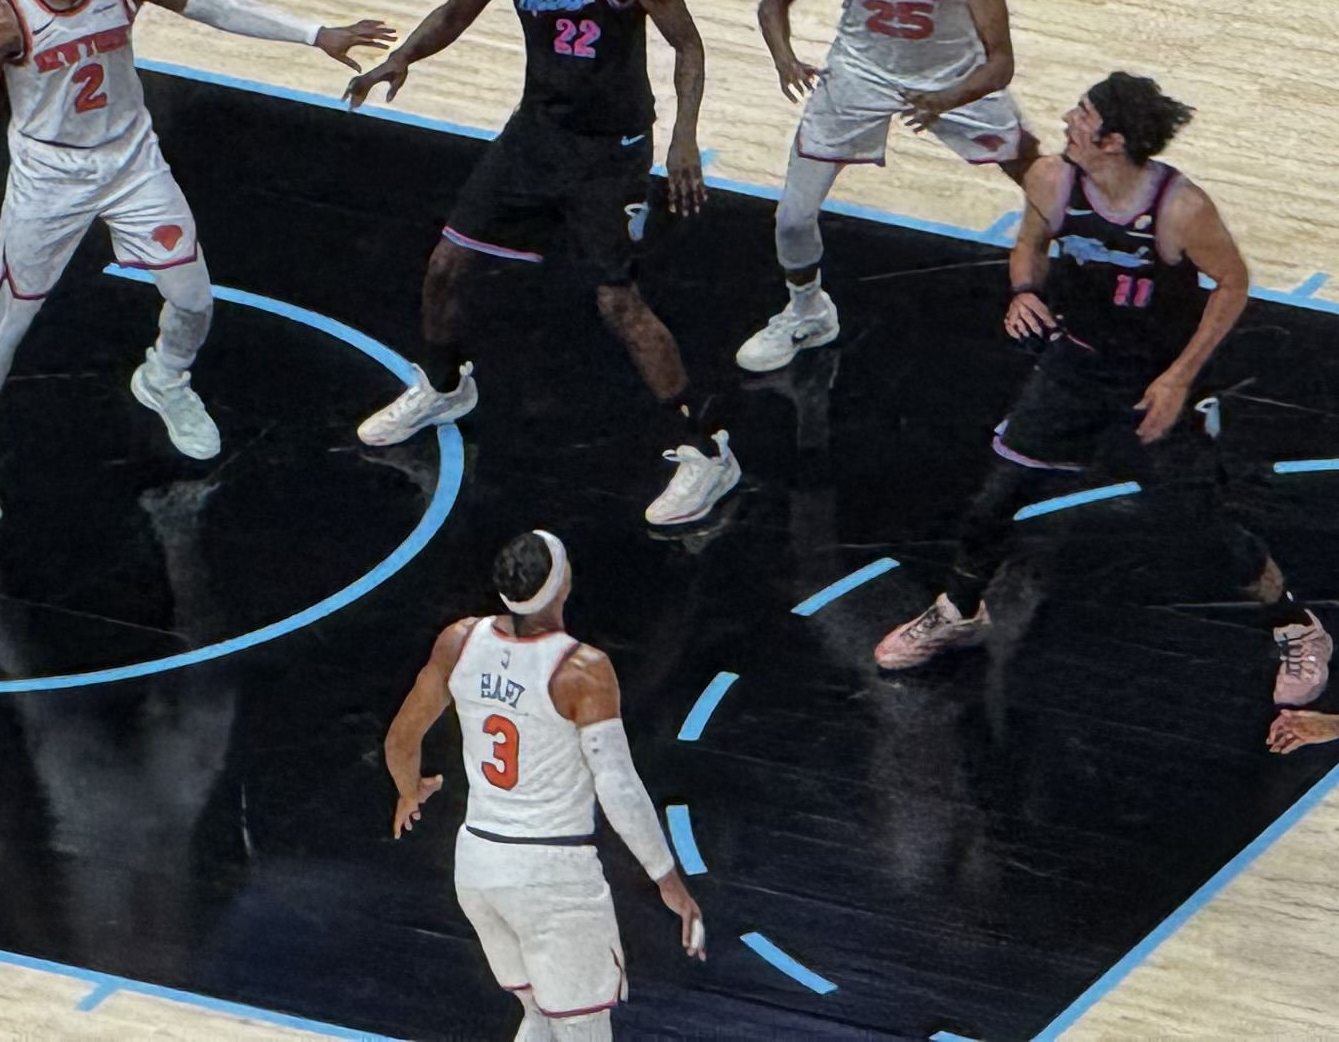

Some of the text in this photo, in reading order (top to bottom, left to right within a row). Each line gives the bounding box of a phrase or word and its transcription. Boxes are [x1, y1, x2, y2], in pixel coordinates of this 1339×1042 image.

[553, 18, 601, 59] 22
[862, 0, 934, 40] 25
[71, 62, 108, 114] 2
[480, 713, 520, 792] 3
